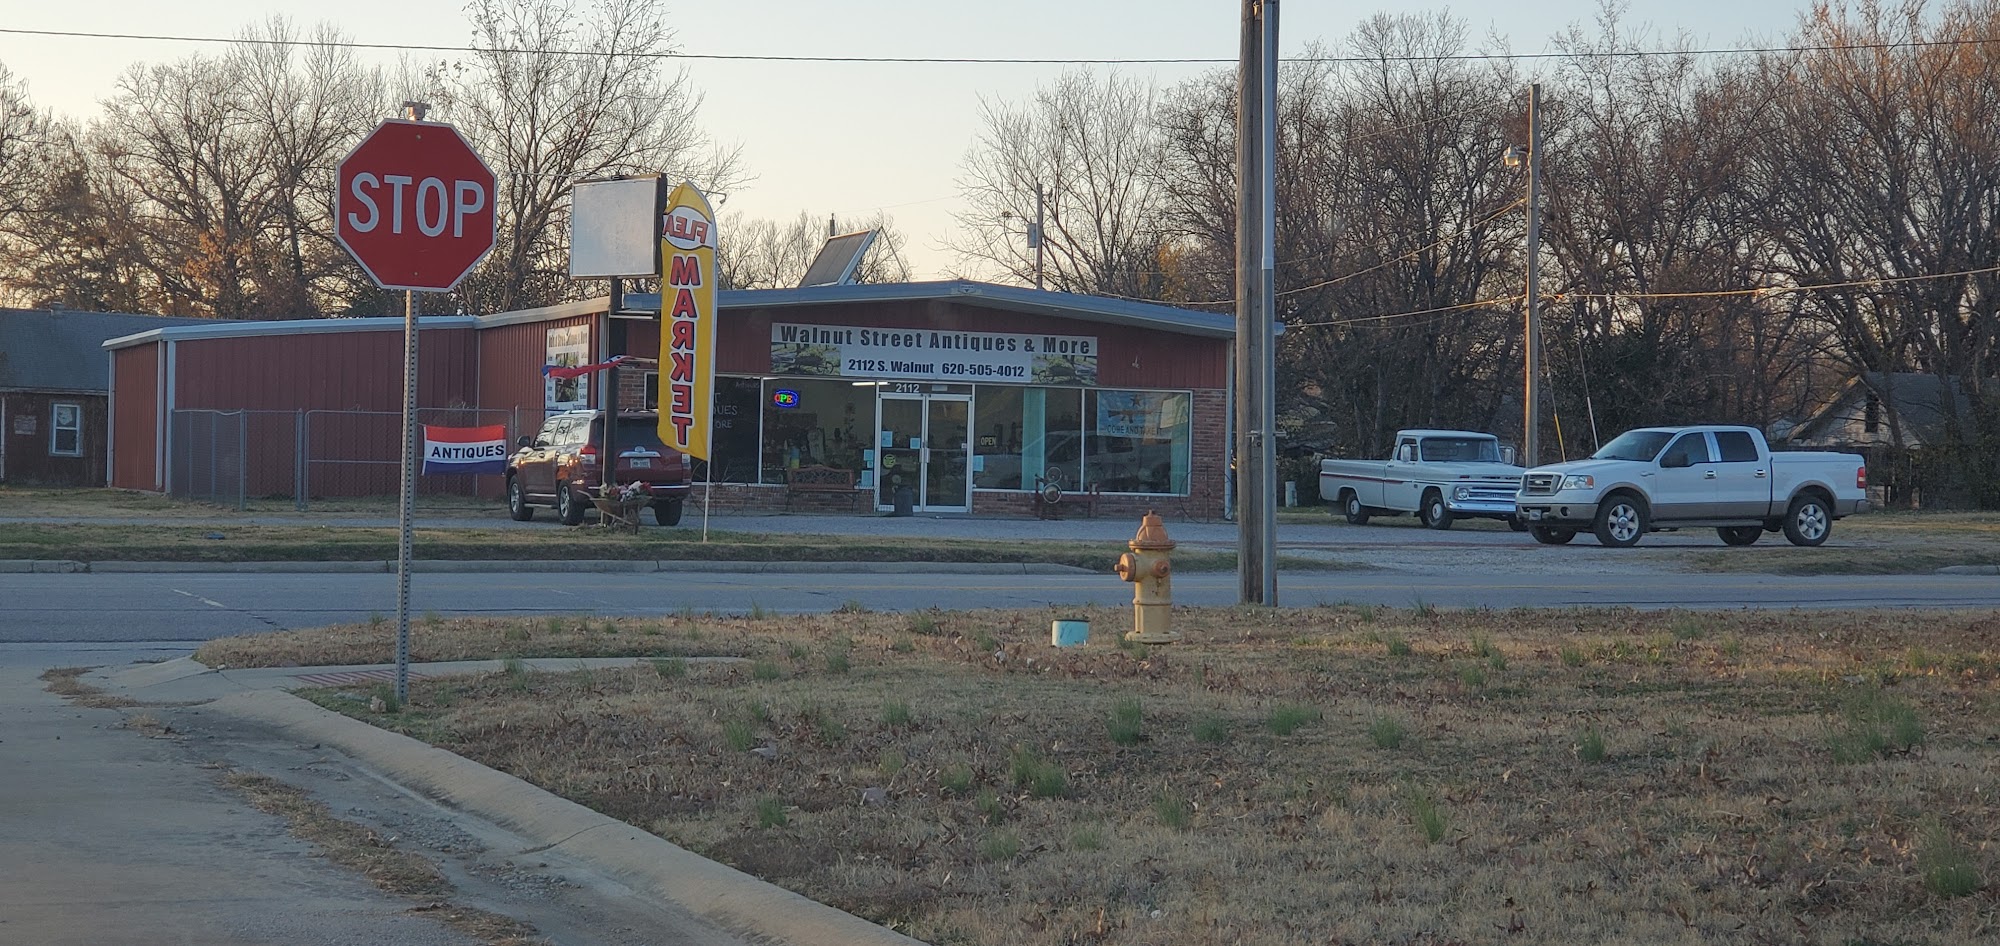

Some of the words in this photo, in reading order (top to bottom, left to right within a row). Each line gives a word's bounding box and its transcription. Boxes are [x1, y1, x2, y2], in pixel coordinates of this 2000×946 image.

[348, 172, 485, 238] STOP
[780, 325, 853, 345] Walnut
[860, 329, 922, 348] Street
[929, 332, 1017, 352] Antiques
[1024, 338, 1035, 352] &
[1043, 336, 1090, 354] More
[848, 359, 875, 371] 2112
[877, 360, 889, 372] S.
[890, 360, 935, 374] Walnut
[941, 363, 1025, 377] 620-505-4012
[895, 383, 920, 393] 2112
[980, 436, 997, 446] OPEN
[431, 444, 505, 459] ANTIQUES
